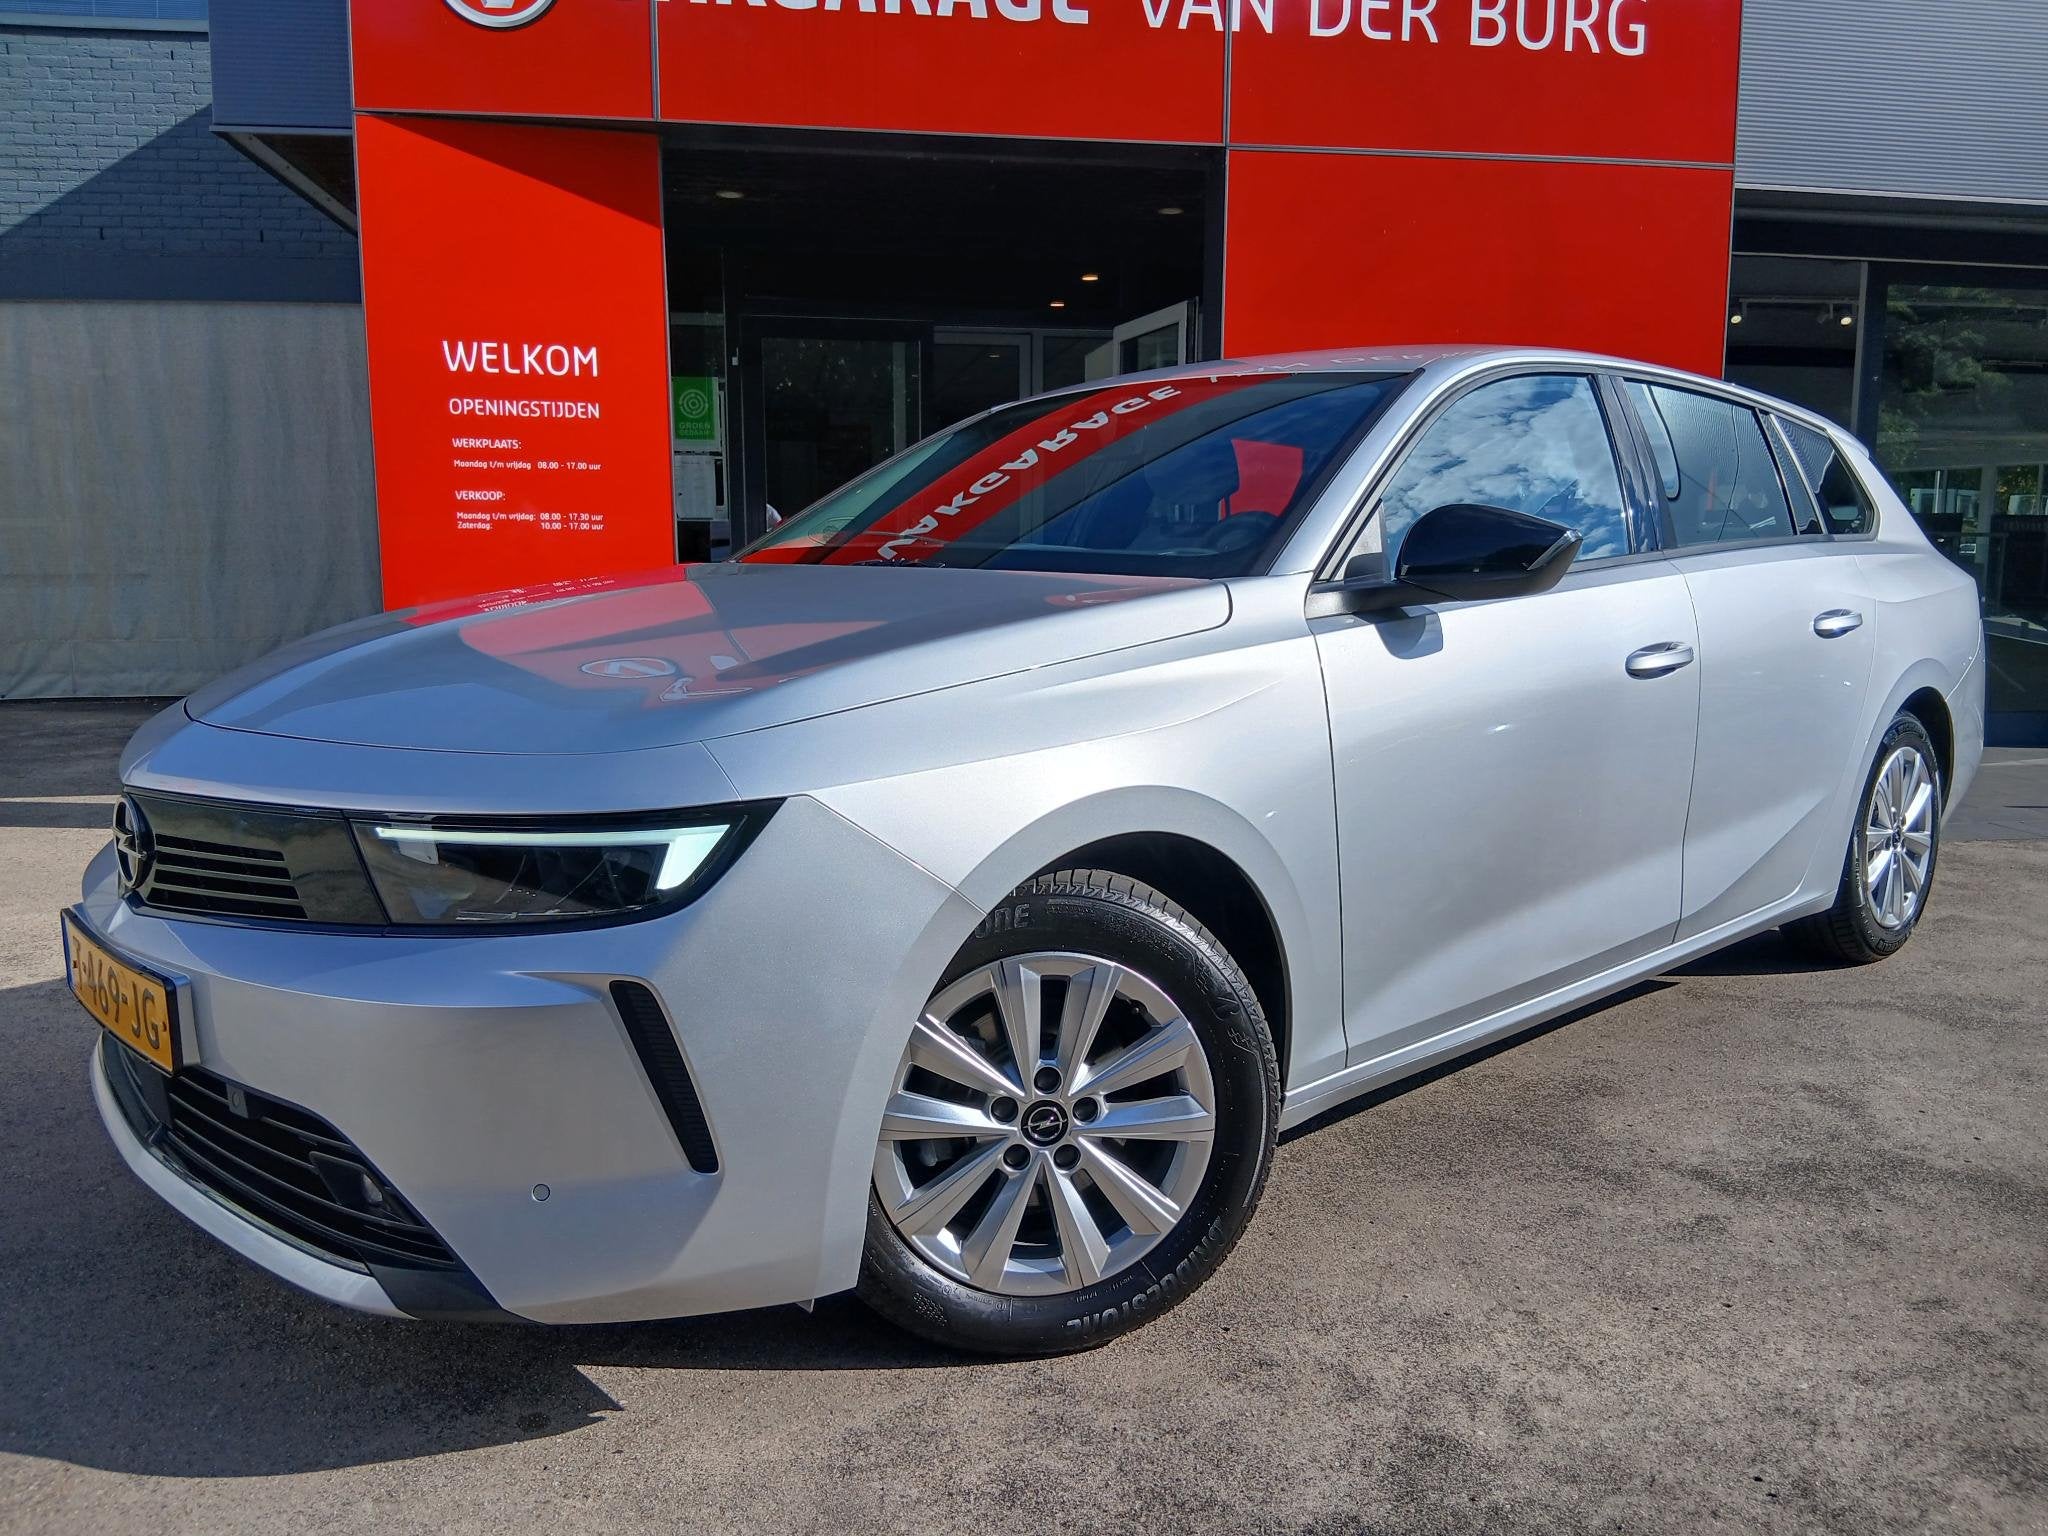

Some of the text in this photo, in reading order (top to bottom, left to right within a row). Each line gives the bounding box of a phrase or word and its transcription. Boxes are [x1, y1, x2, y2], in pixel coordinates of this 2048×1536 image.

[1309, 0, 1439, 43] DER
[1469, 0, 1647, 57] BURG
[442, 340, 598, 377] WELKOM
[449, 398, 600, 419] OPENINGSTIJDEN
[452, 438, 522, 449] WERKPLAATS:
[454, 459, 488, 469] Maandag
[489, 460, 505, 468] t/m
[506, 461, 532, 471] vrijdag
[537, 461, 559, 470] 08.00
[566, 462, 587, 470] 17.00
[455, 490, 506, 501] VERKOOP:
[456, 512, 491, 521] Maandag
[492, 512, 507, 520] t/m
[508, 513, 536, 522] vrijdag:
[539, 513, 562, 521] 08.00
[568, 513, 590, 521] 17.30
[457, 521, 493, 530] Zaterdag:
[540, 522, 562, 530] 10.00
[568, 522, 590, 530] 17.00
